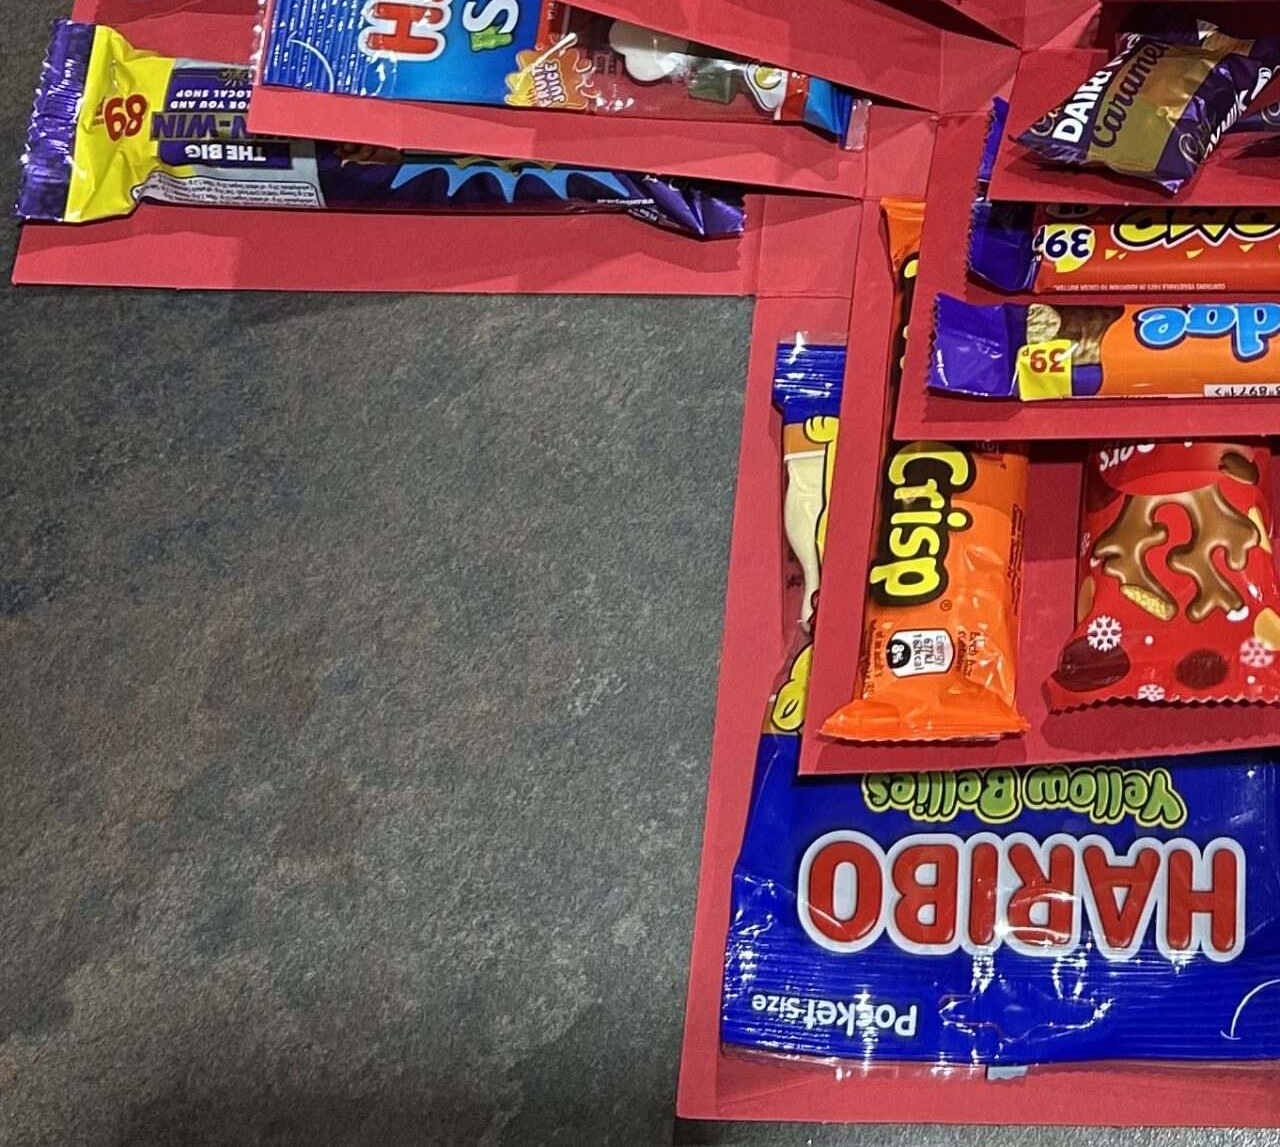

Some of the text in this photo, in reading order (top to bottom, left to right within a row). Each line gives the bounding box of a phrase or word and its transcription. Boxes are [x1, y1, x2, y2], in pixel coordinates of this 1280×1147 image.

[175, 89, 252, 98] LOCAL SHOP
[531, 66, 552, 107] FRUIT
[545, 62, 565, 102] JUICE
[170, 100, 196, 109] AND
[200, 100, 224, 109] YOU
[150, 114, 252, 140] N-WIN
[184, 144, 267, 162] THE BIG
[870, 444, 970, 600] Crisp
[936, 635, 946, 666] Energy
[861, 766, 1186, 828] Yellow Bellies
[802, 834, 1242, 959] HARIBO
[752, 993, 917, 1037] Pocket size
